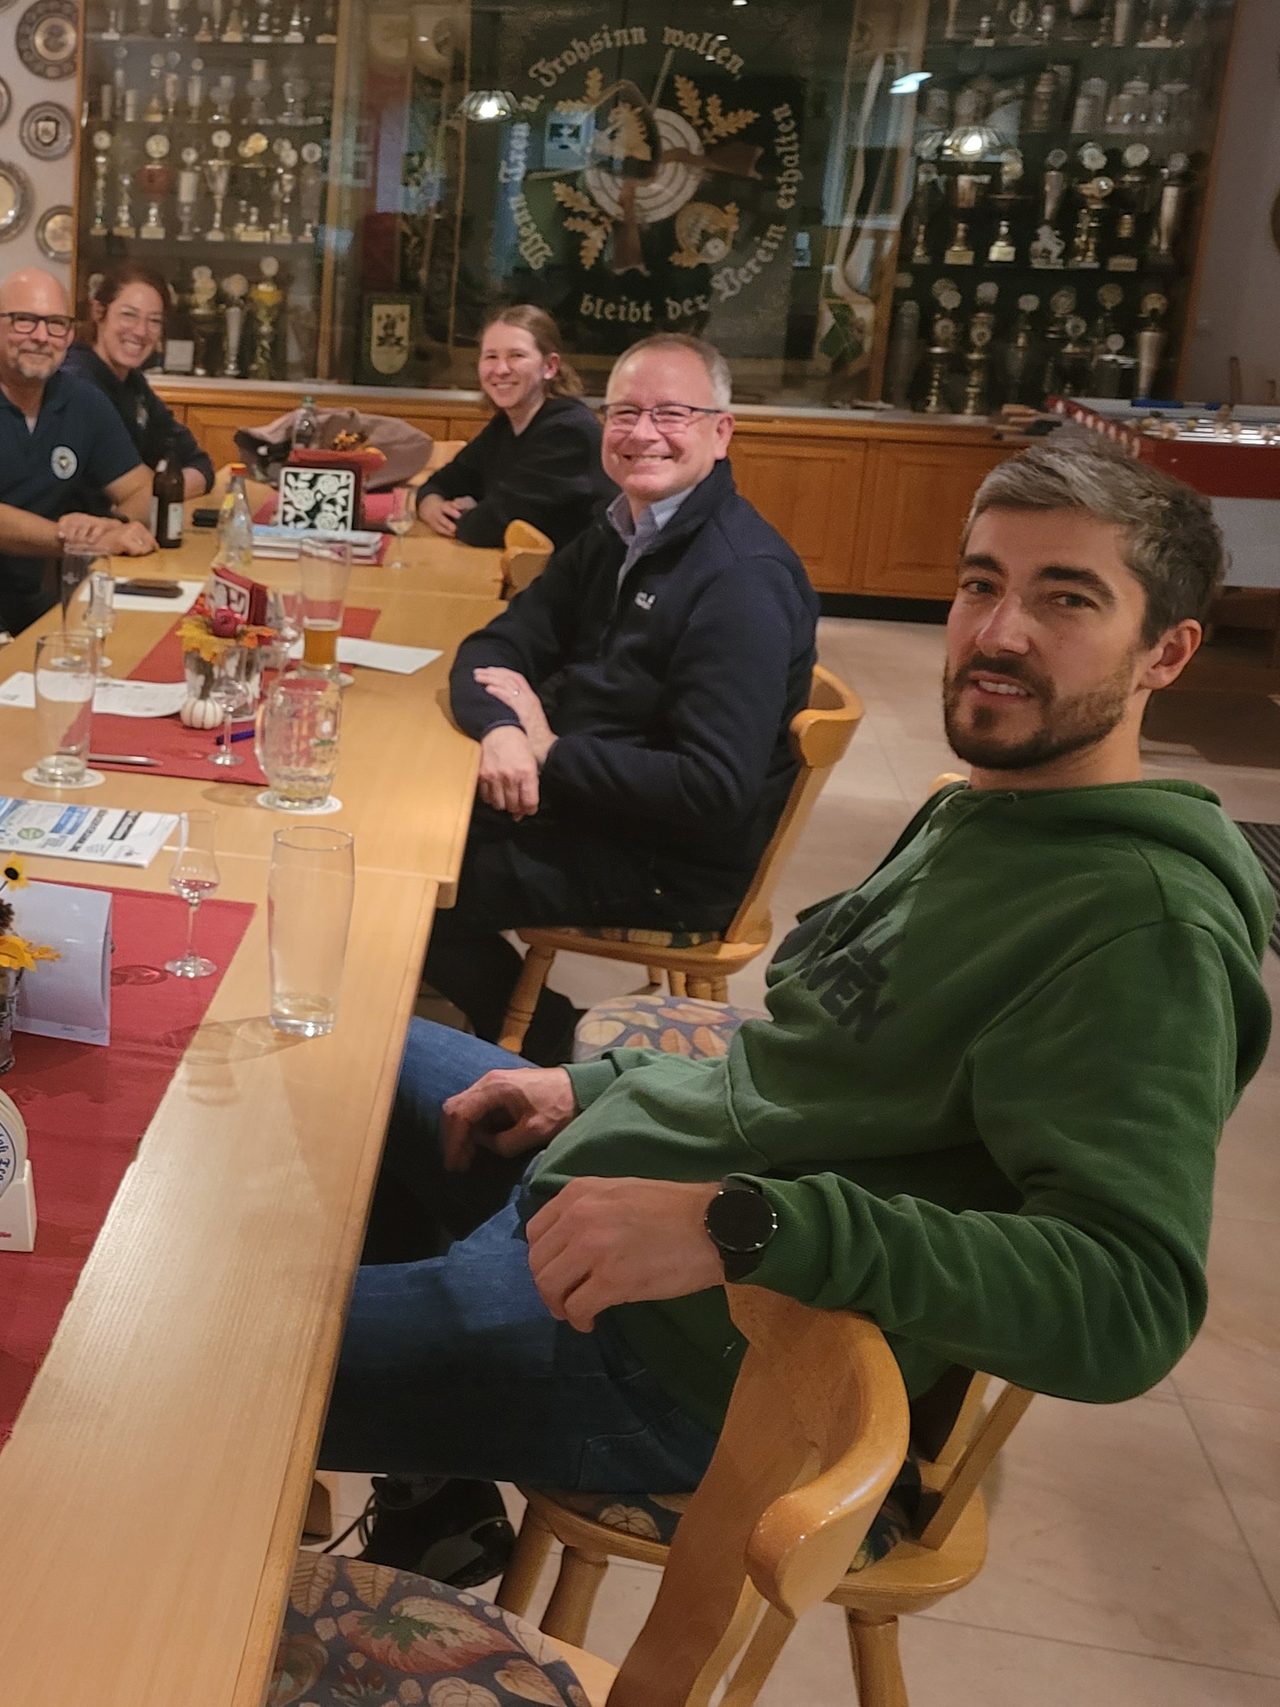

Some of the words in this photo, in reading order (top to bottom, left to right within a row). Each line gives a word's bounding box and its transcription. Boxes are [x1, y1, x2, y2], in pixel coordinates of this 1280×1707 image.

[528, 23, 648, 88] Frohsinn
[579, 292, 653, 323] bleibt
[666, 294, 710, 320] der
[710, 224, 787, 303] Verein
[772, 103, 803, 210] erhalten
